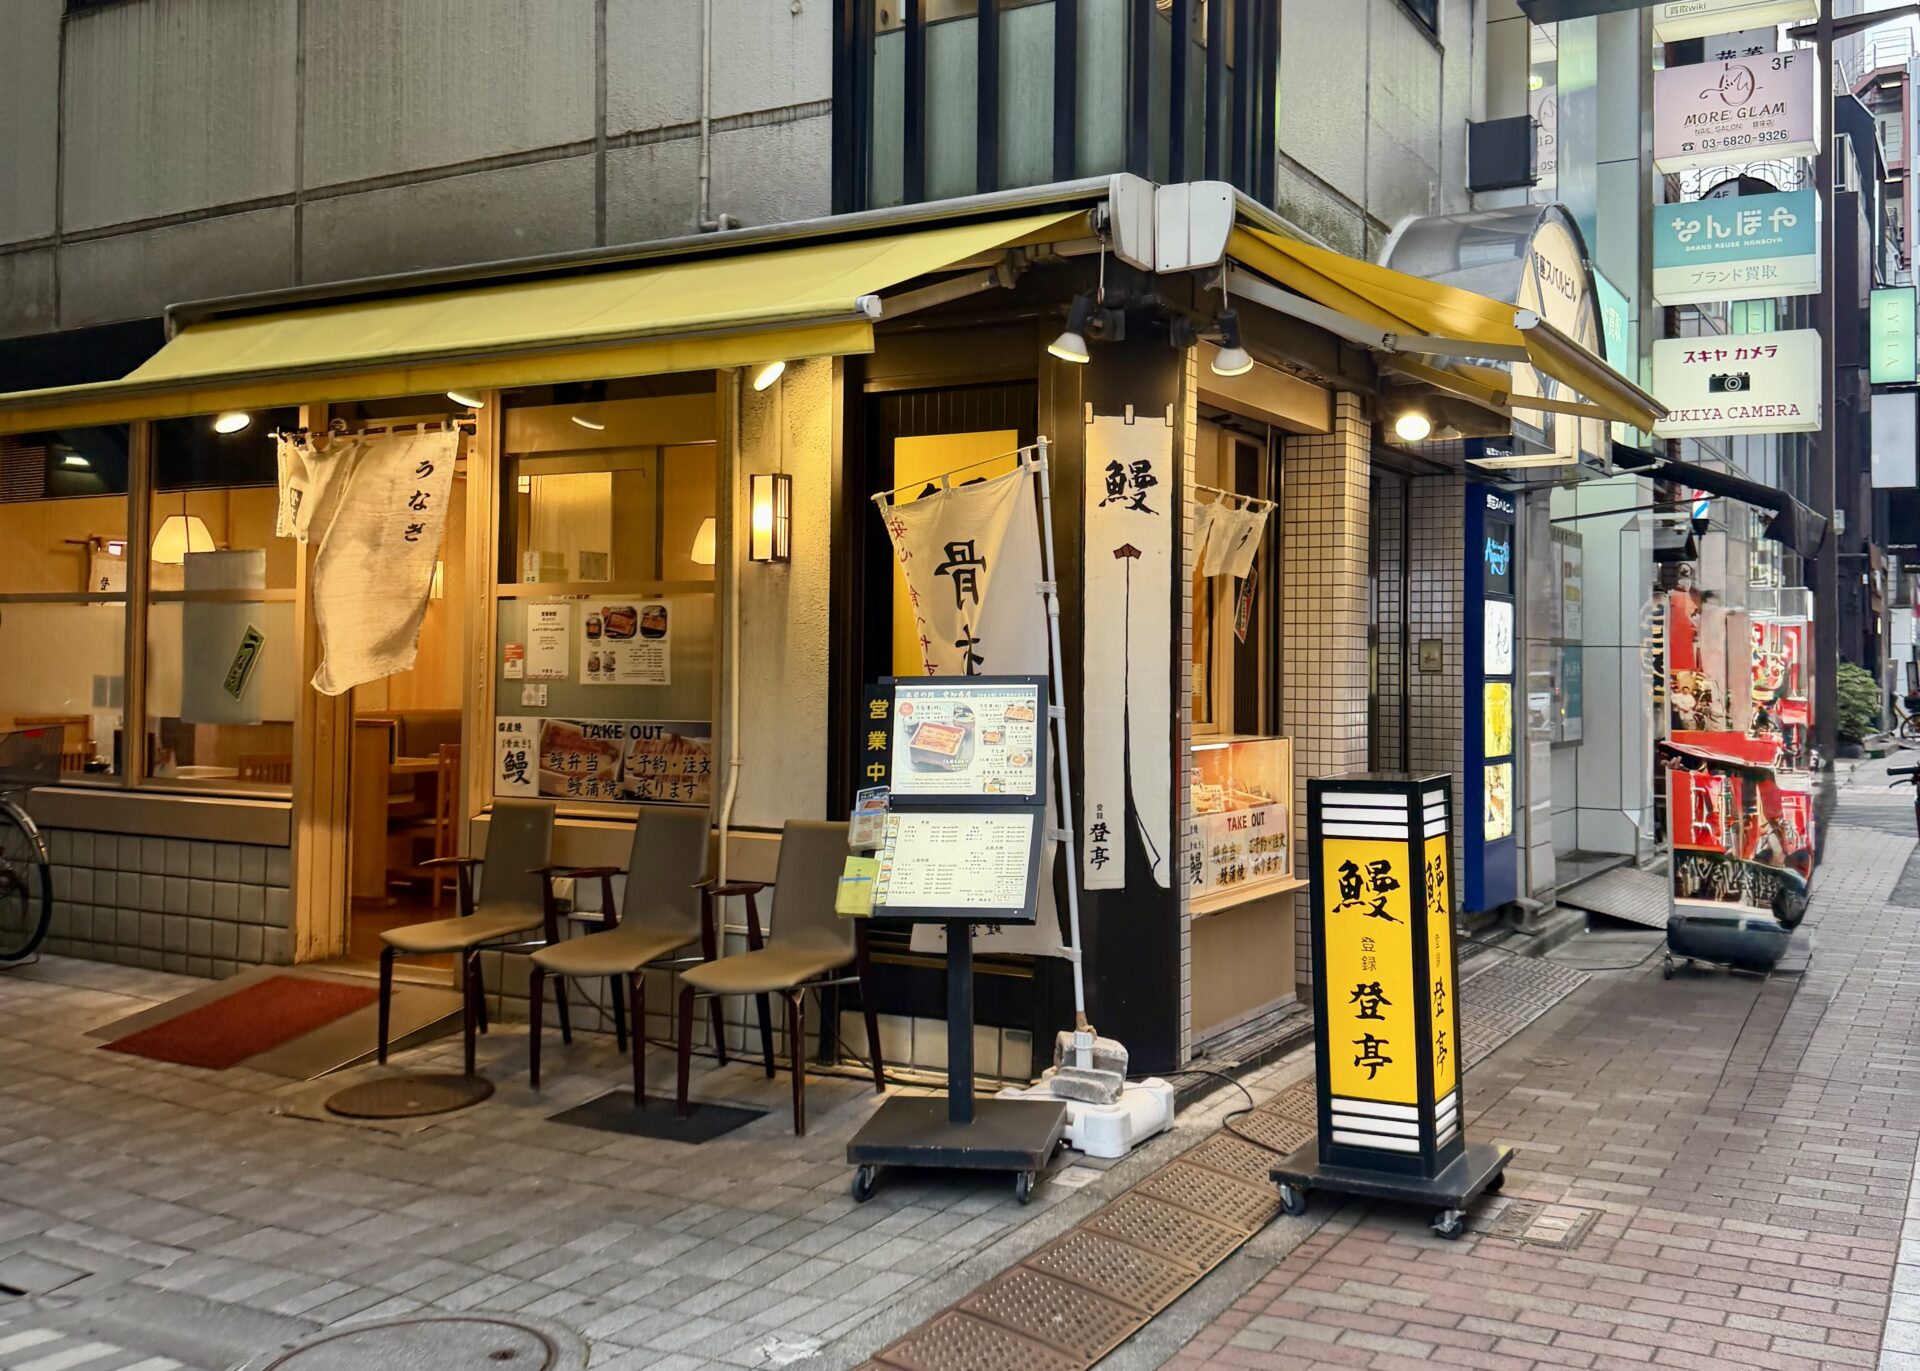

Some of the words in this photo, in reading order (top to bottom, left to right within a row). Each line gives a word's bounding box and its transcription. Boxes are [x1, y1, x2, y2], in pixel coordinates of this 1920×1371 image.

[1771, 55, 1793, 71] 3F
[1684, 109, 1731, 126] MORE
[1736, 102, 1785, 119] GLAM
[1694, 127, 1713, 136] NAIL
[1715, 124, 1742, 134] SALON
[1702, 129, 1788, 149] 03-6820-9326
[1671, 206, 1797, 243] なんぼや
[1685, 243, 1712, 252] BRAND
[1715, 240, 1740, 249] REUSE
[1744, 237, 1783, 247] NANBOYA
[1691, 264, 1778, 285] ブランド買取
[1683, 349, 1728, 364] スキヤ
[1735, 345, 1778, 361] カメラ
[1658, 408, 1723, 423] UKIYA
[1727, 404, 1801, 420] CAMERA
[1098, 459, 1159, 515] 鰻
[403, 460, 434, 542] うなぎ
[581, 724, 624, 739] TAKE
[630, 725, 664, 740] OUT
[866, 699, 890, 783] 営業中
[502, 750, 531, 785] 鰻
[549, 751, 599, 772] 鰻弁当
[625, 755, 712, 775] ご予約・注文
[567, 775, 620, 798] 鰻蒲焼
[635, 777, 699, 800] 承ります
[1227, 815, 1248, 832] TAKE
[1251, 811, 1265, 828] OUT
[1089, 822, 1112, 870] 登亭
[1332, 859, 1404, 925] 鰻
[1425, 854, 1447, 917] 鰻
[1360, 936, 1377, 972] 登録
[1348, 981, 1393, 1081] 登亭
[1433, 975, 1448, 1079] 登亭
